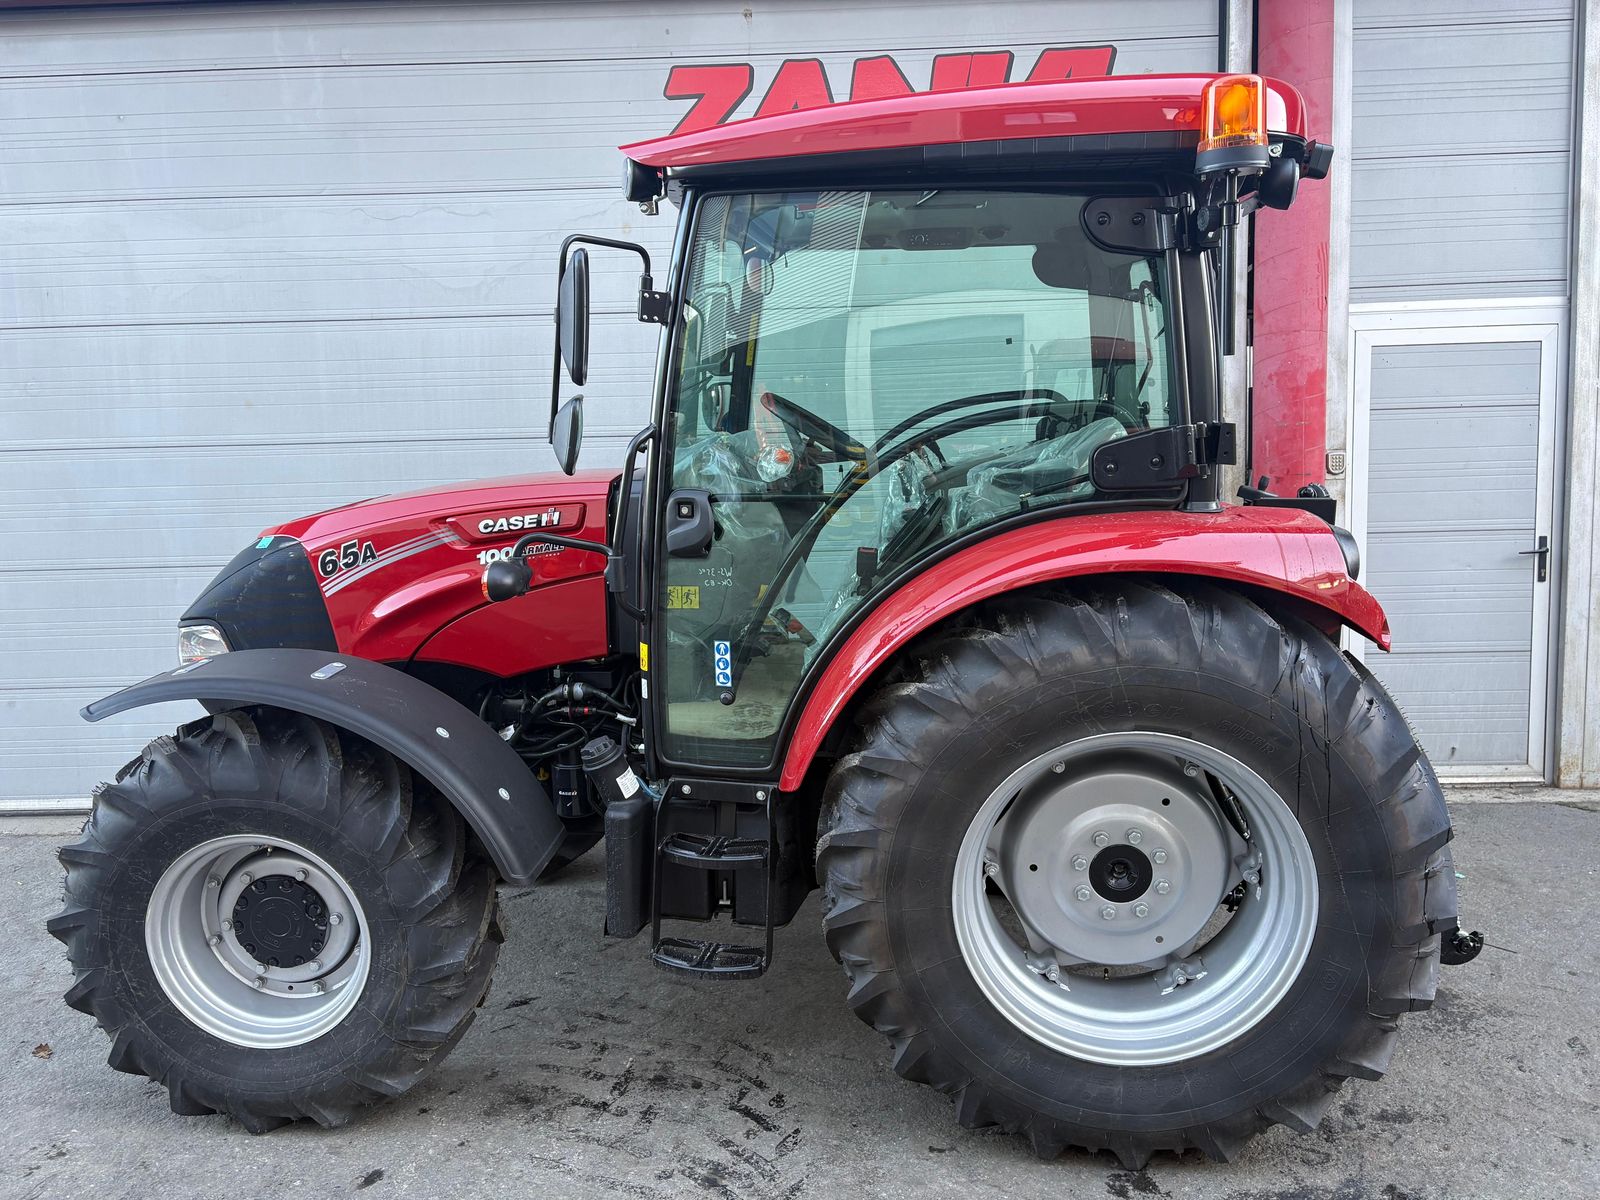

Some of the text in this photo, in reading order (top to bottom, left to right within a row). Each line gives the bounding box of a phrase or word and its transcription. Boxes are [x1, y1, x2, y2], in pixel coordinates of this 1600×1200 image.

[477, 513, 540, 534] CASE
[317, 538, 379, 578] 65A
[476, 546, 514, 565] 100
